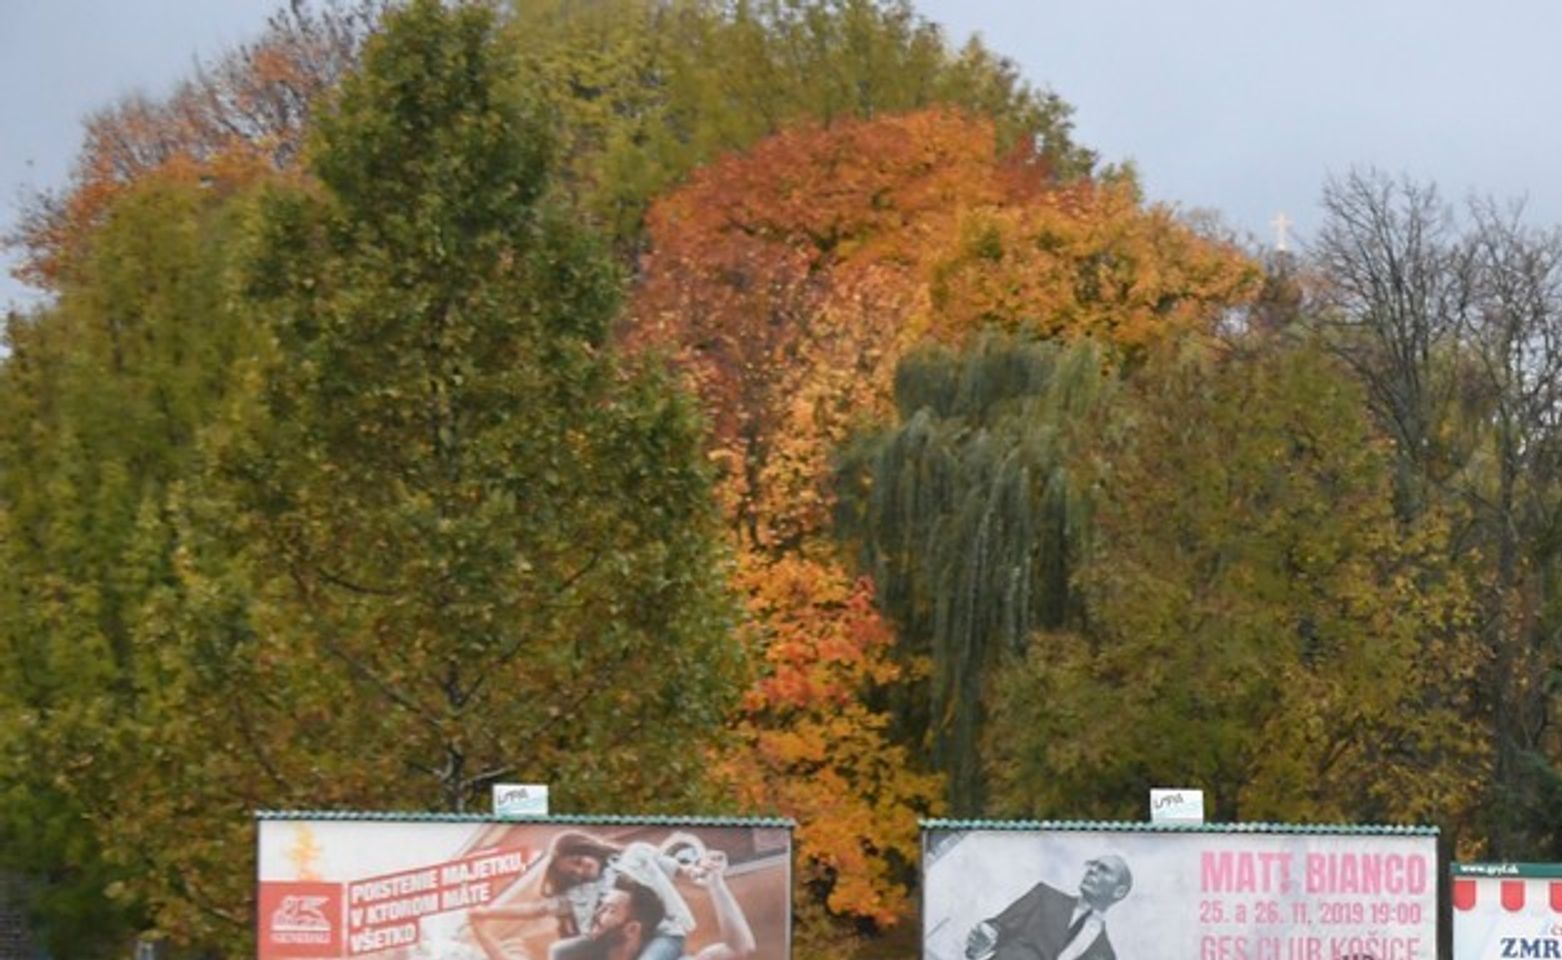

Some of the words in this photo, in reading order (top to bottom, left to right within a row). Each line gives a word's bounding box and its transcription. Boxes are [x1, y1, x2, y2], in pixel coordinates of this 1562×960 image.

[352, 869, 438, 904] POISTENIE
[442, 853, 529, 886] MAJETKU,
[1201, 851, 1293, 894] MATT
[1305, 852, 1427, 895] BIANCO
[352, 907, 364, 928] V
[366, 893, 440, 924] KTOROM
[1200, 901, 1229, 924] 25.
[1235, 904, 1247, 924] a
[1255, 901, 1285, 924] 26.
[1319, 902, 1364, 924] 2019
[1371, 902, 1422, 925] 19:00
[352, 923, 416, 953] VŠETKO
